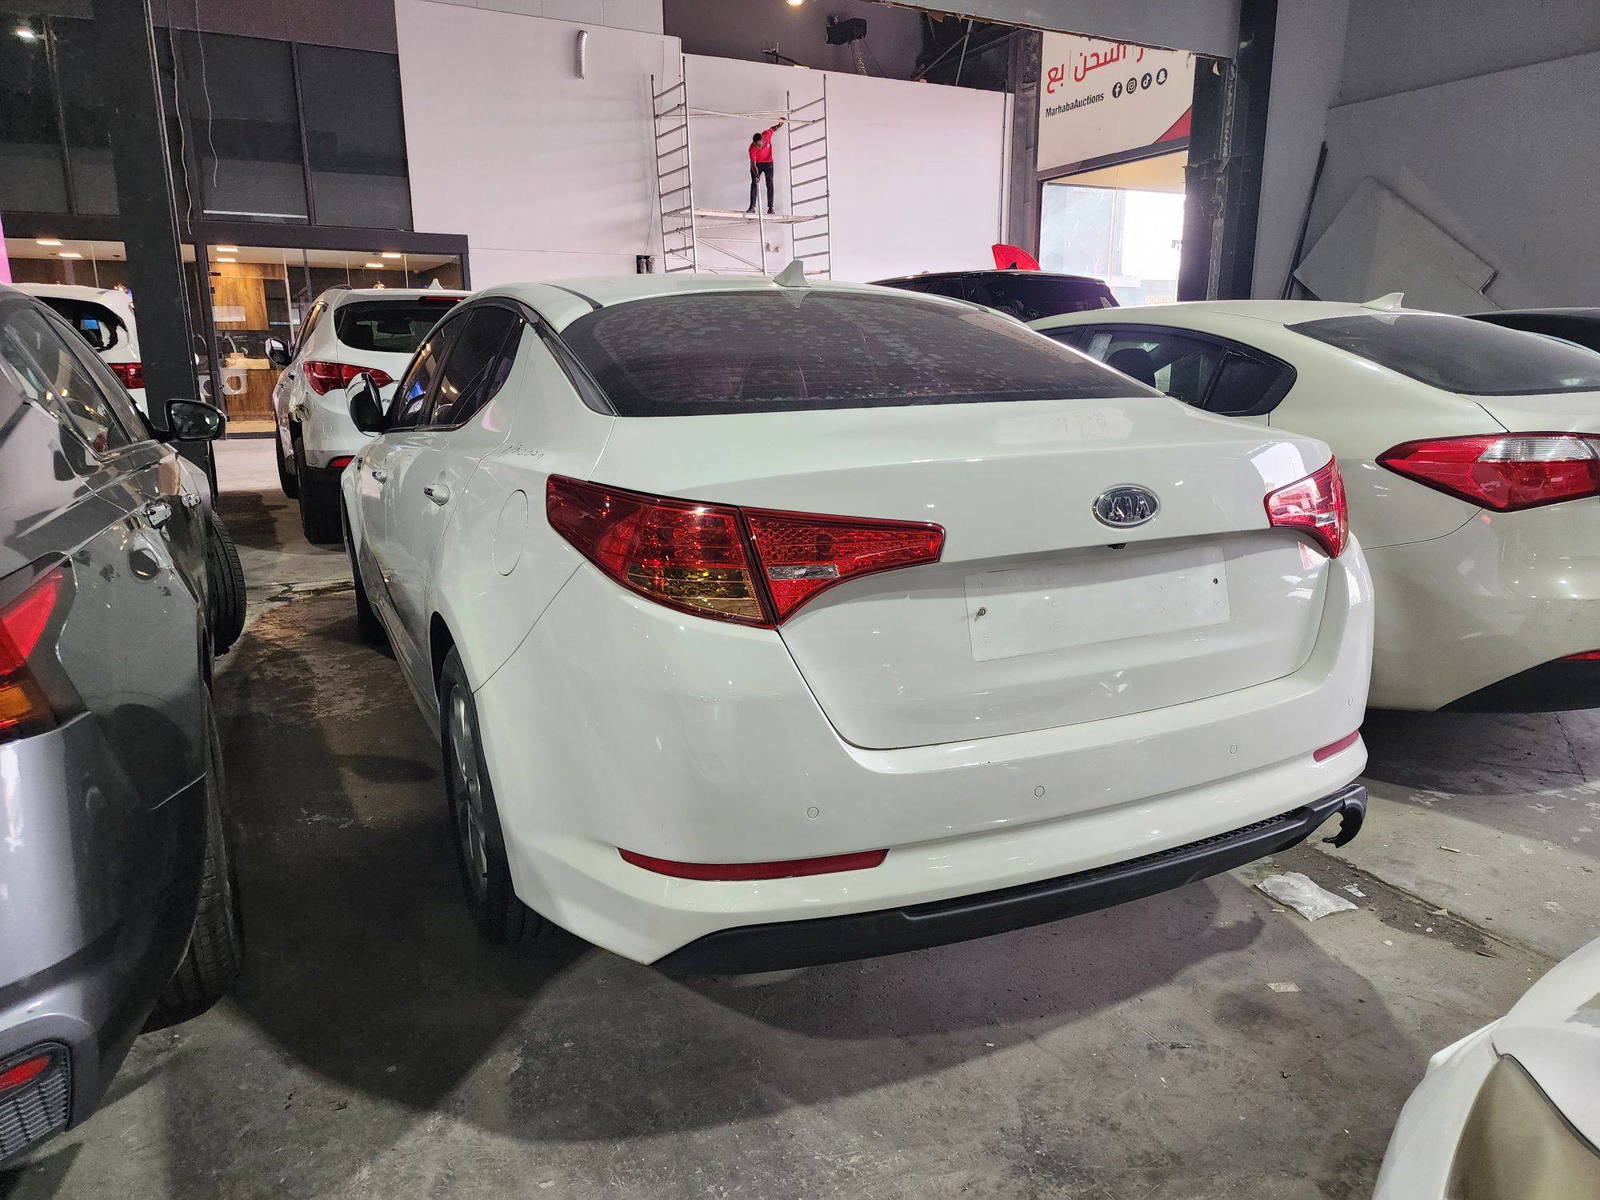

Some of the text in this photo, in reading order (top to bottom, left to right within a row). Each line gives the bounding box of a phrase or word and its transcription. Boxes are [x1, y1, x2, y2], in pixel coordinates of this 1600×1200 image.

[1047, 64, 1065, 94] بع
[1045, 92, 1105, 117] MarhabaAuctions
[1105, 494, 1152, 521] KIA
